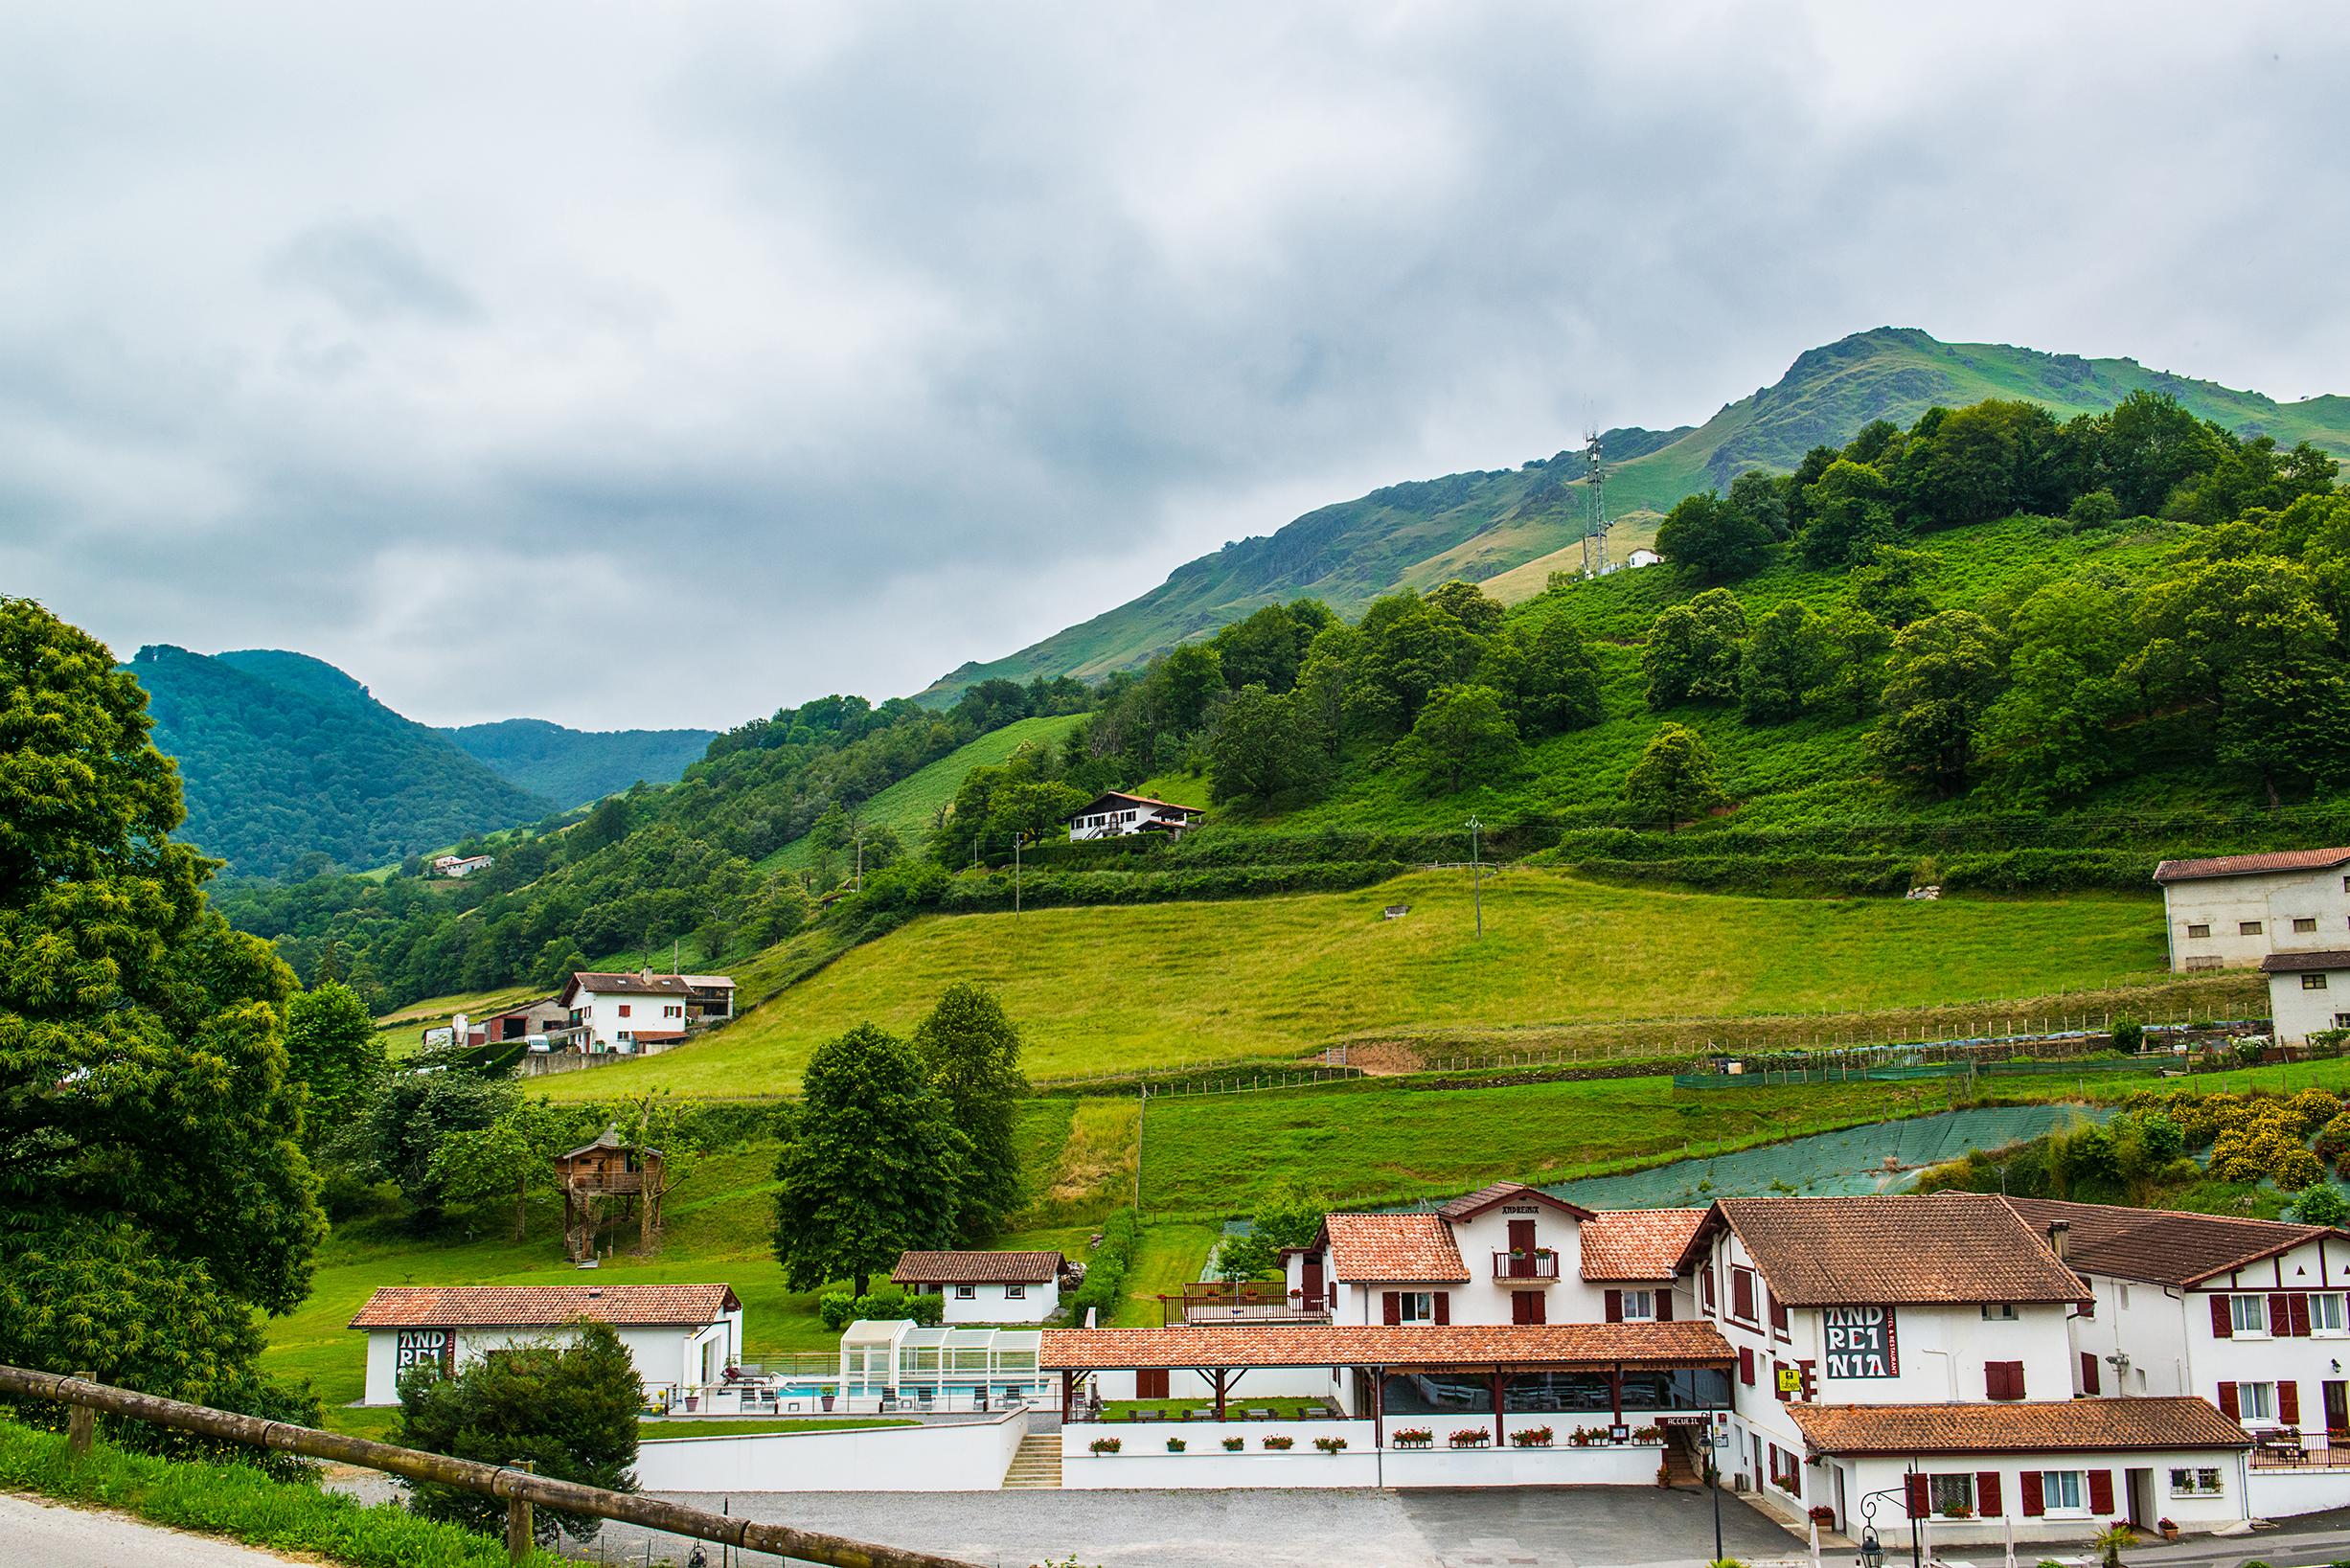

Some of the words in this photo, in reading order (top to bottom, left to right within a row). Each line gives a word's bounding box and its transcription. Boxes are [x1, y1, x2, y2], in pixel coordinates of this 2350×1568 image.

[1826, 1307, 1883, 1327] AND
[399, 1331, 445, 1349] AND
[1828, 1328, 1880, 1350] REI
[1827, 1353, 1887, 1376] NIA
[1889, 1335, 1898, 1374] RESTAURANT
